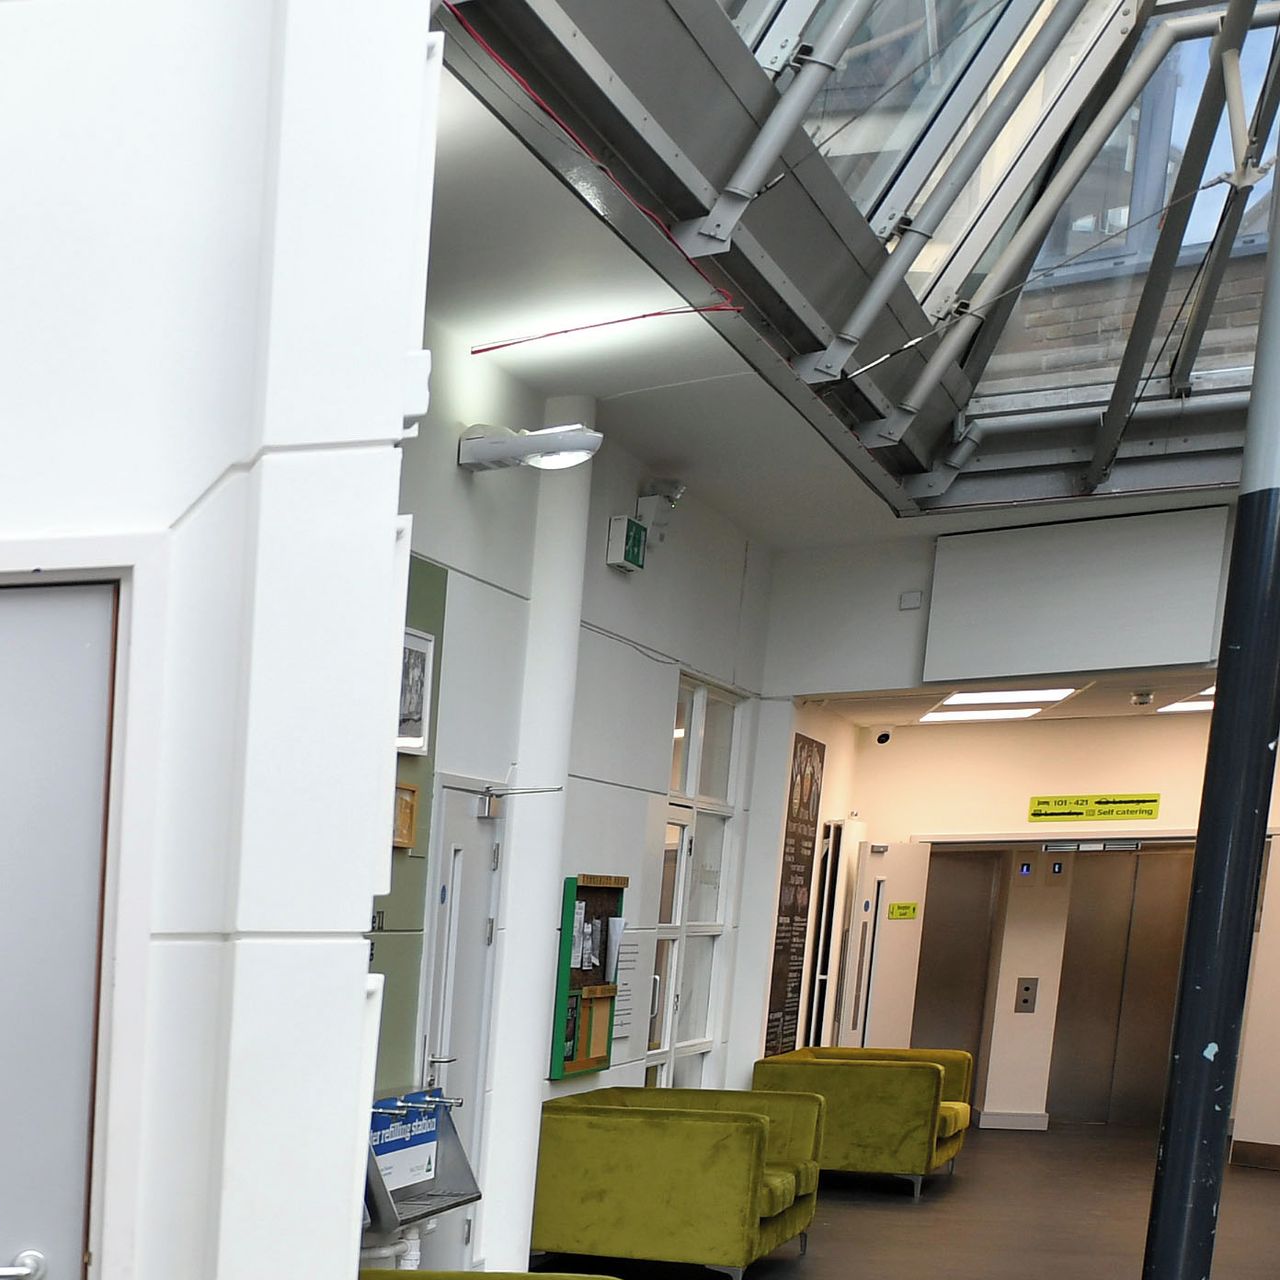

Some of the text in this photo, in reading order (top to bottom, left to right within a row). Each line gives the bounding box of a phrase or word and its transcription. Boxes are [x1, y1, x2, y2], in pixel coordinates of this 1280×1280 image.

[1053, 799, 1068, 807] 101
[1116, 808, 1154, 816] catering
[381, 1121, 411, 1143] refilling
[412, 1117, 436, 1135] station
